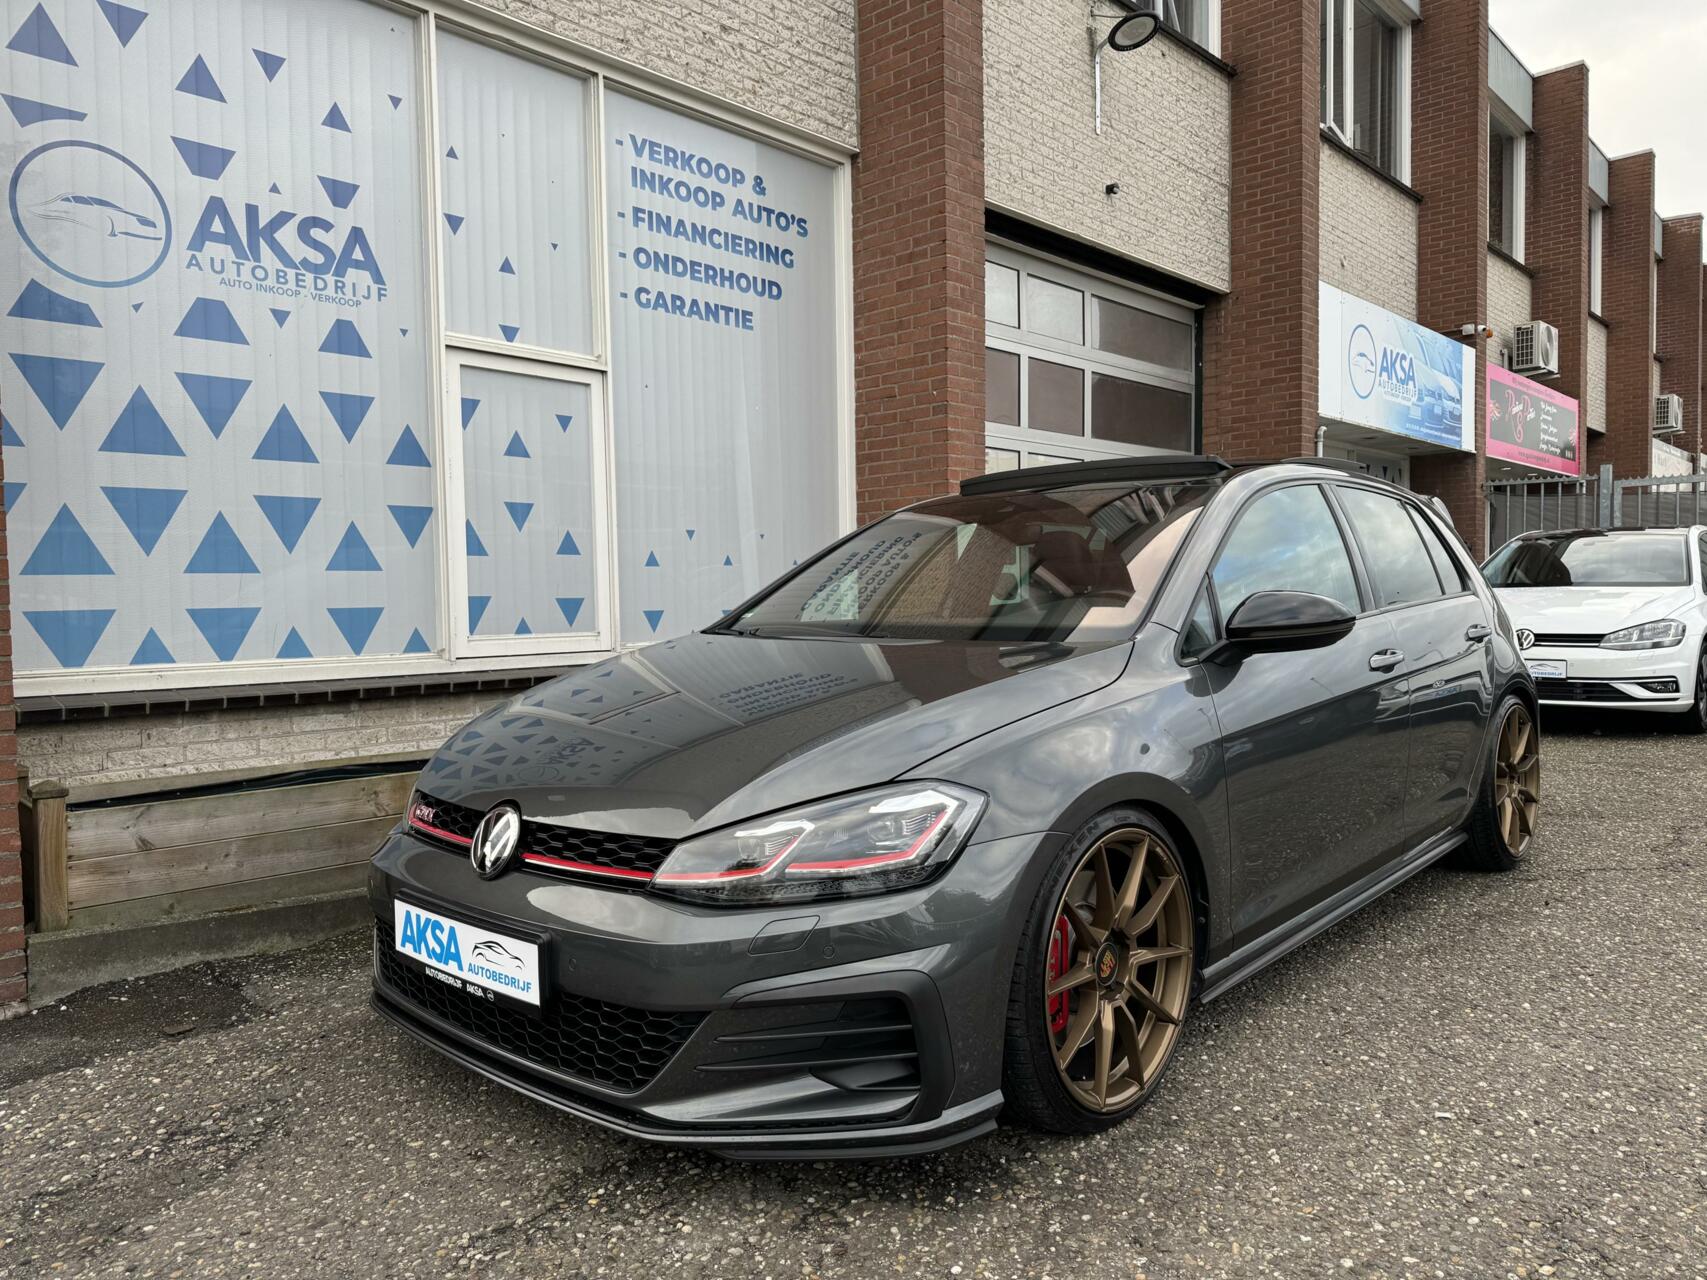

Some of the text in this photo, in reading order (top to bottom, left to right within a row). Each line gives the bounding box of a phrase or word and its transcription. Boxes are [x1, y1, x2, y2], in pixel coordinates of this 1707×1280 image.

[629, 133, 746, 188] VERKOOP
[752, 175, 767, 197] &
[631, 166, 809, 238] INKOOP AUTO'S
[186, 195, 386, 286] AKSA
[632, 206, 795, 269] FINANCIERING
[185, 253, 388, 302] AUTOBEDRIJF
[219, 276, 253, 292] AUTO
[255, 280, 301, 299] INKOOP
[310, 291, 362, 309] VERKOOP
[633, 246, 783, 301] ONDERHOUD
[634, 286, 754, 331] GARANTIE
[1378, 379, 1418, 398] AUTOBEDRIJF
[1379, 346, 1417, 389] AKSA
[400, 909, 464, 973] AKSA
[425, 965, 485, 999] AUTOBEDRIJF AKSA
[467, 962, 533, 994] AUTOBEDRIJF
